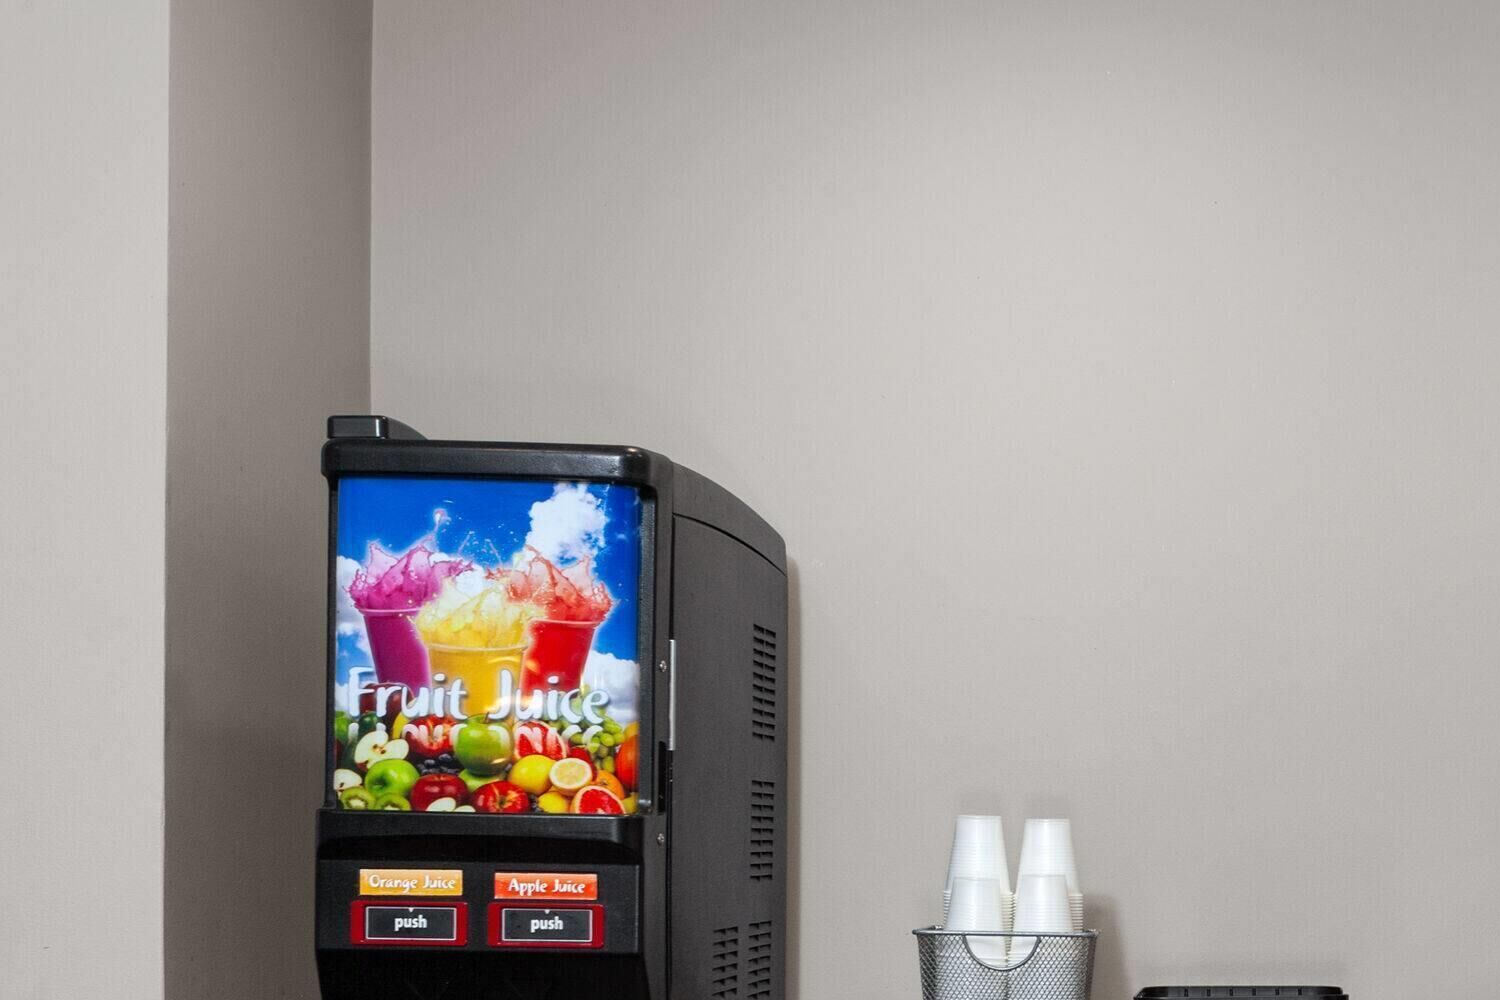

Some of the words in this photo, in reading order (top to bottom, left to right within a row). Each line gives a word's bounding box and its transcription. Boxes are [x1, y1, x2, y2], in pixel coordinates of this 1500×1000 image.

[349, 667, 467, 719] Fruit
[489, 669, 609, 724] Juice
[368, 875, 418, 893] Orange
[422, 876, 456, 890] Juice
[508, 878, 547, 896] Apple
[552, 878, 585, 894] Juice
[394, 914, 428, 932] push
[530, 916, 564, 933] push
